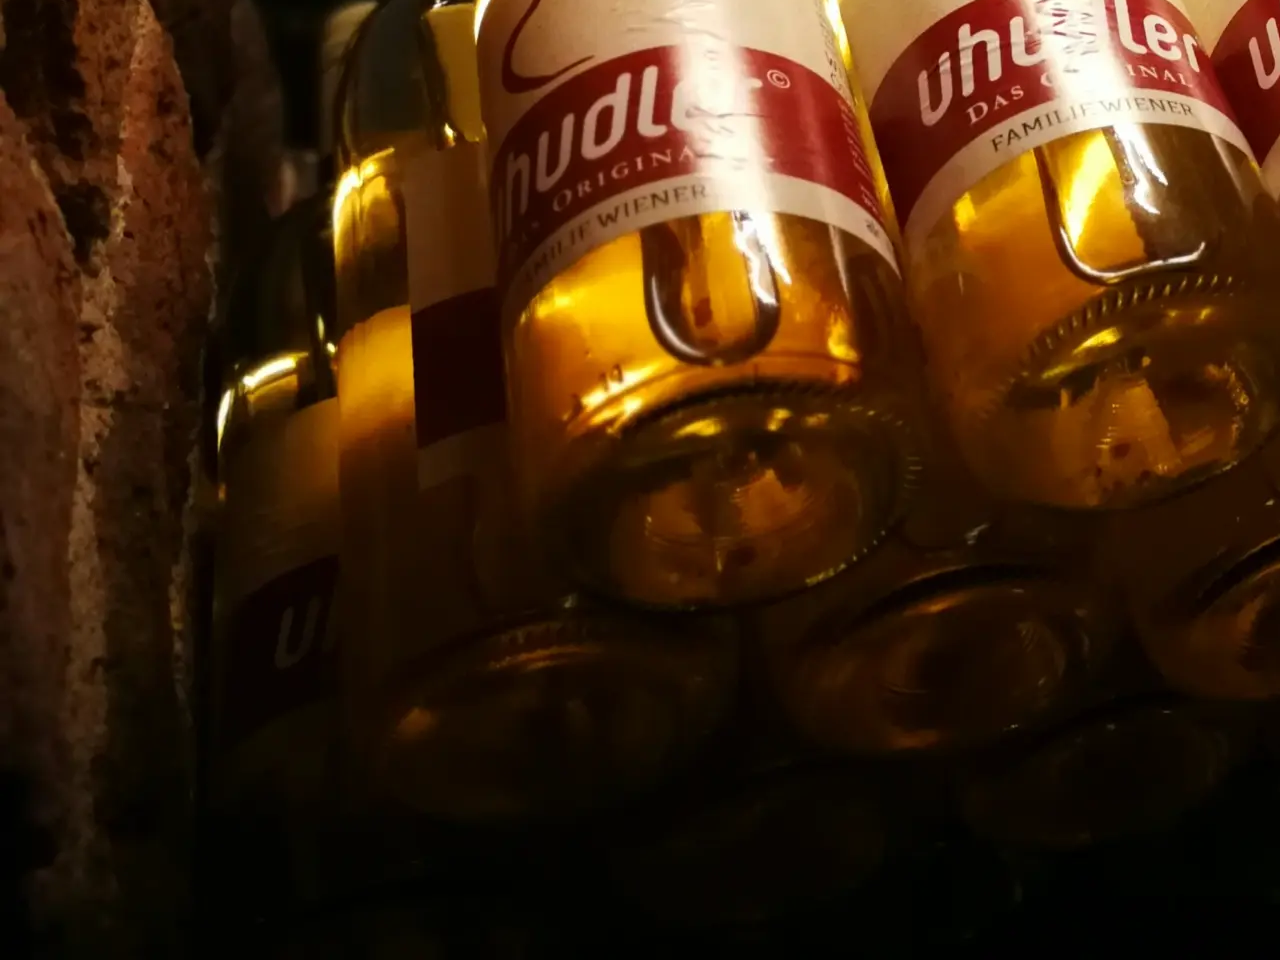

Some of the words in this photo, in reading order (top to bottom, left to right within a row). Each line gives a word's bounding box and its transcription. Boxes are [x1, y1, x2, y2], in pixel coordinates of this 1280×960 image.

[966, 84, 1024, 125] DAS
[990, 98, 1097, 153] FAMILIE
[1098, 95, 1195, 118] WIENER
[597, 182, 707, 230] WIENER
